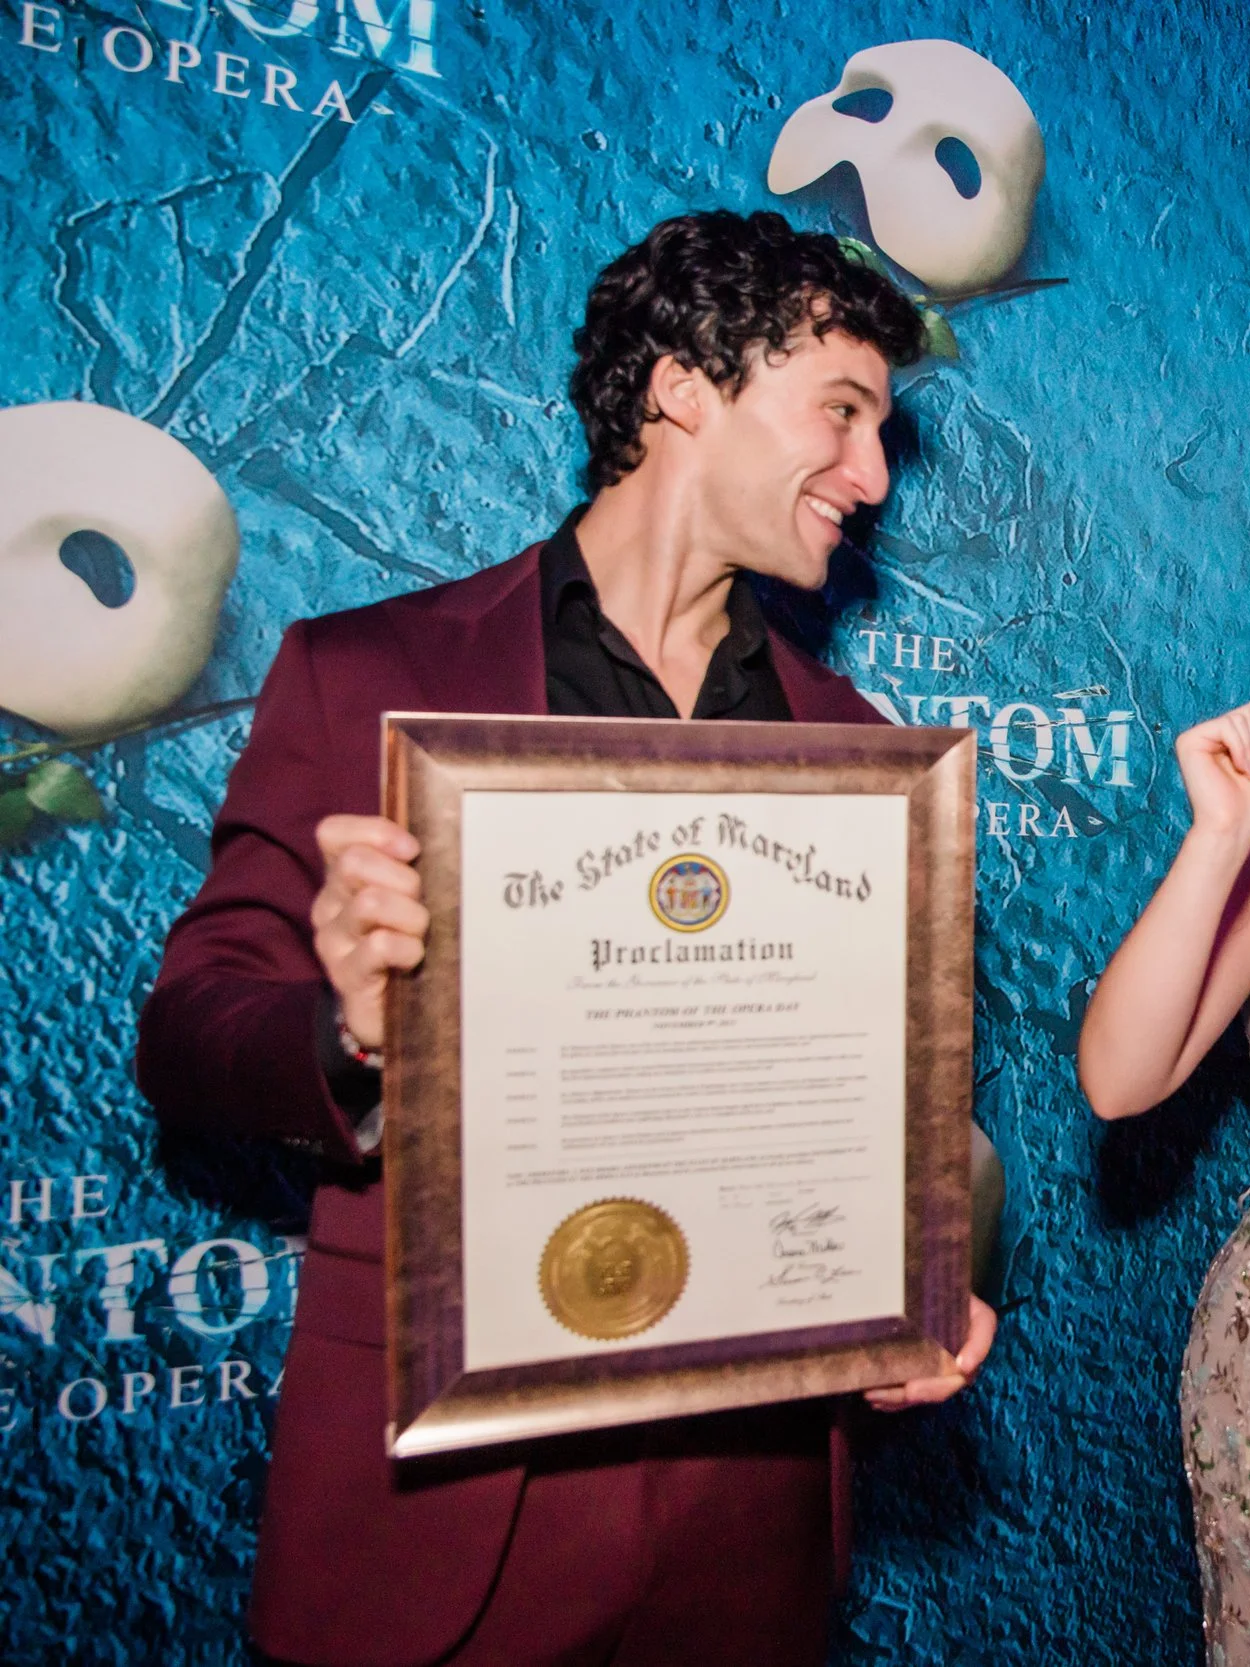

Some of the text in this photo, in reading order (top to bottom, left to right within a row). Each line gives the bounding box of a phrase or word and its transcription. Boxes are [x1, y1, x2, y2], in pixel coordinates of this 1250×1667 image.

[103, 26, 356, 124] OPERA
[859, 630, 956, 671] THE
[975, 803, 1078, 838] ERA
[503, 812, 872, 908] The State of Maryland
[590, 938, 794, 971] Proclamation
[9, 1174, 109, 1224] HE
